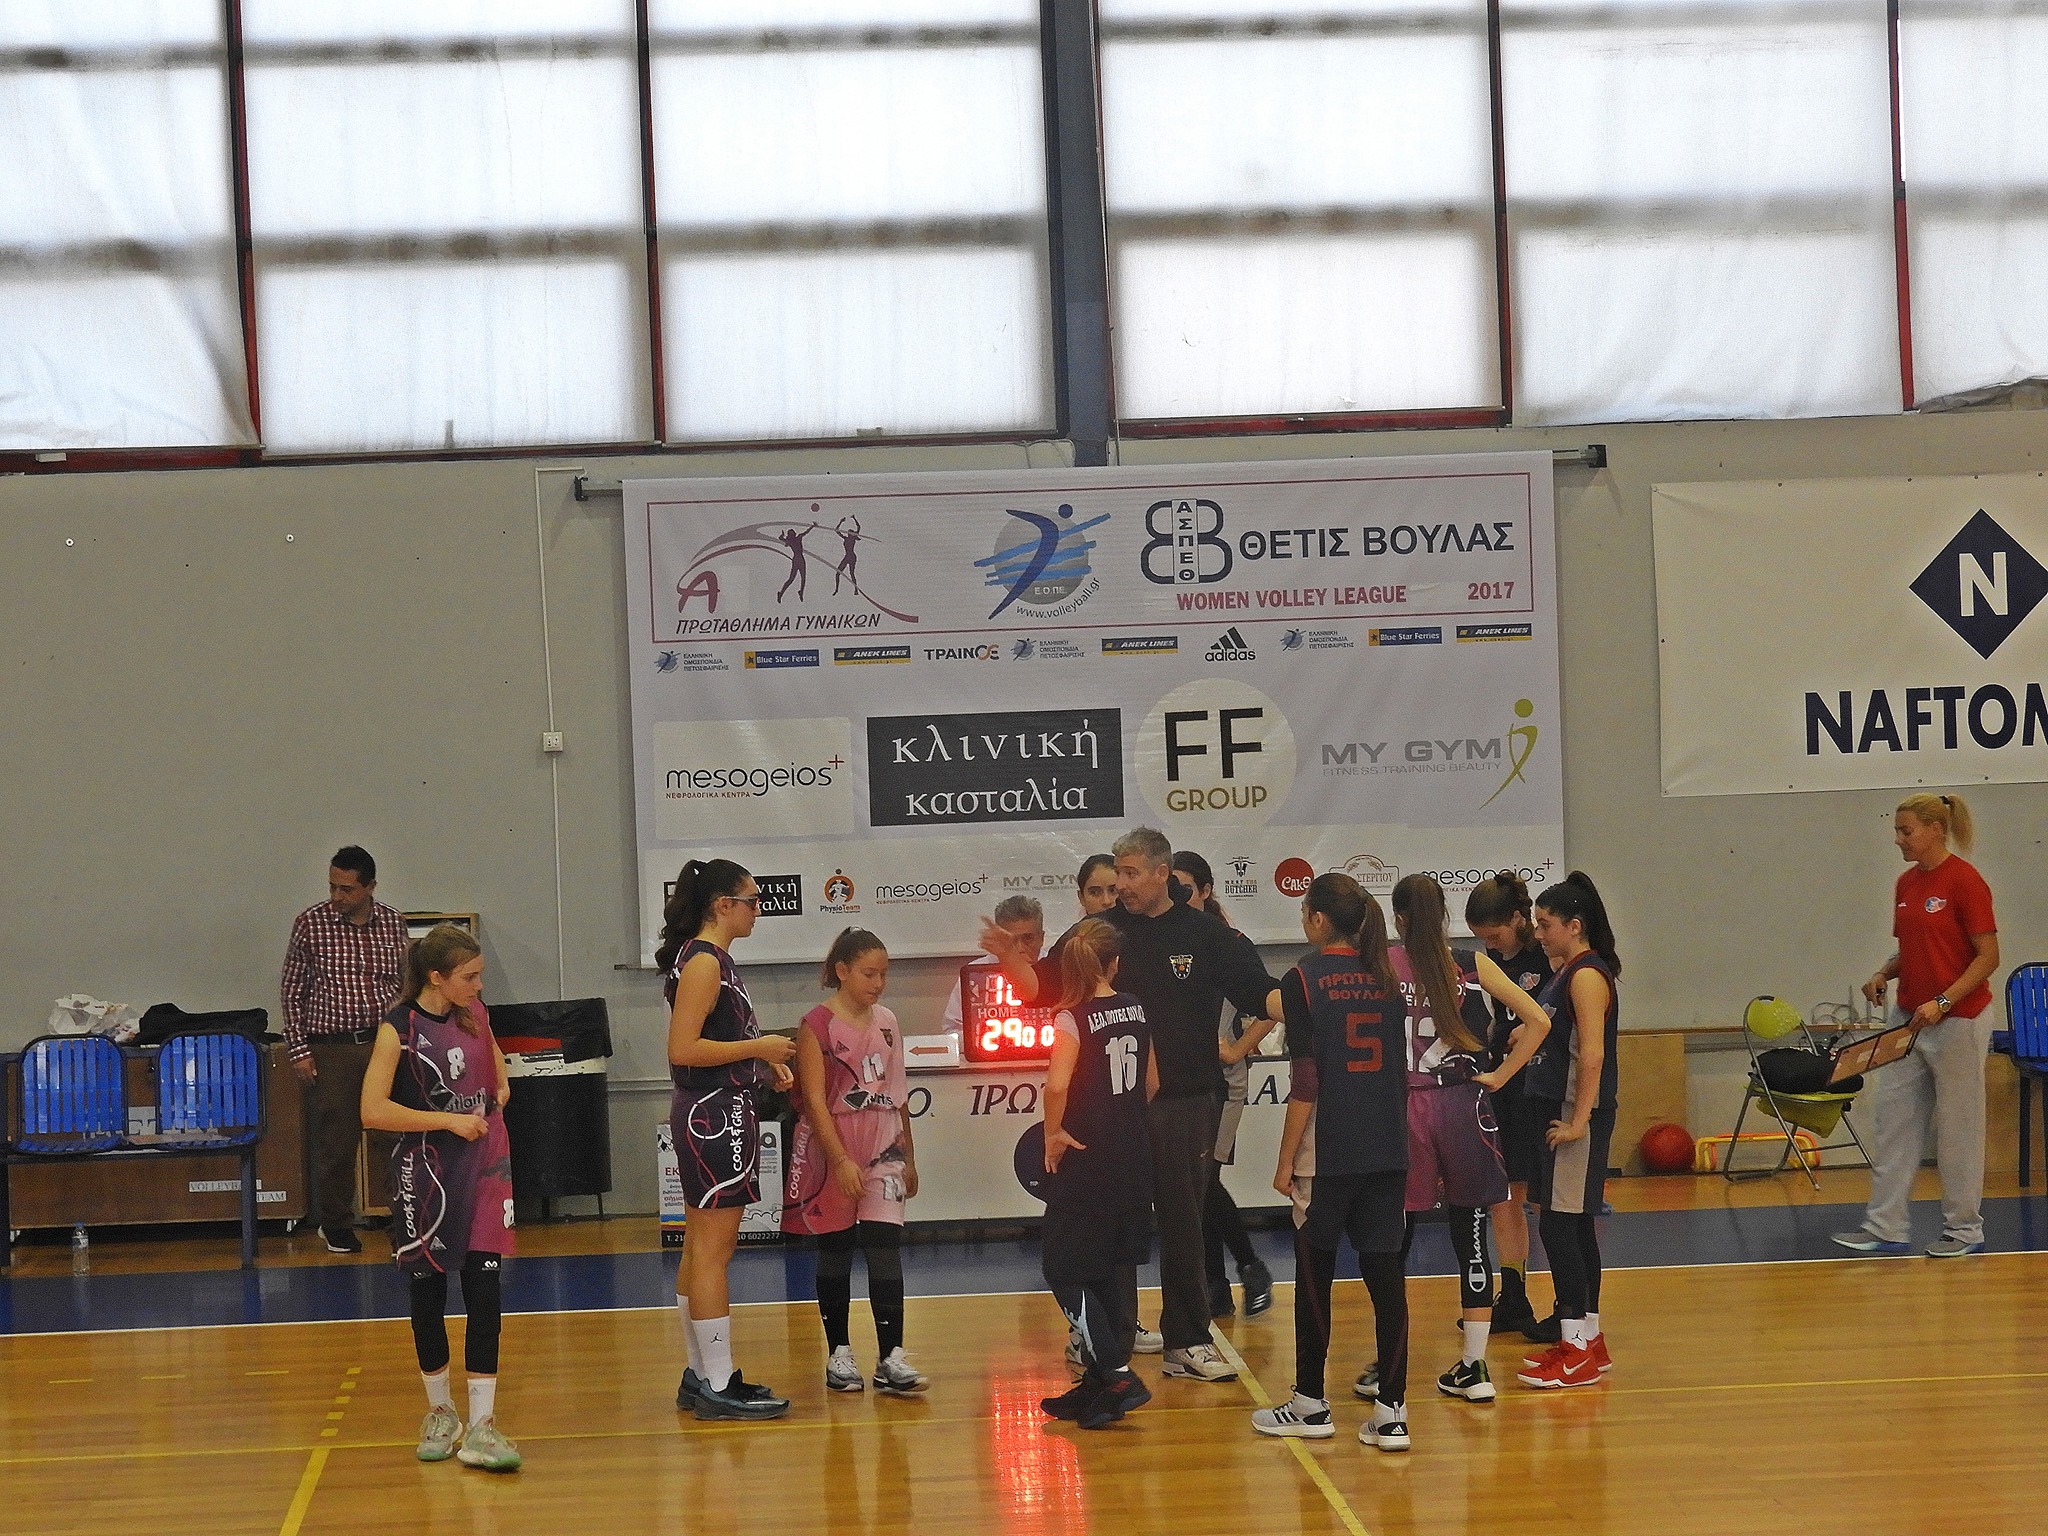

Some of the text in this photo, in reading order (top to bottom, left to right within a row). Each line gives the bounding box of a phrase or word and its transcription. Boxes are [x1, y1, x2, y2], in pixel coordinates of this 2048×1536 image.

[1238, 521, 1515, 560] ΘΕΤΙΣ ΒΟΥΛΑΣ
[1016, 577, 1101, 619] www.volleyball.gr
[1176, 585, 1407, 611] WOMEN VOLLEY LEAGUE
[1467, 581, 1515, 600] 2017
[1958, 552, 2009, 617] N
[675, 613, 881, 635] ΠΡΩΤΑΘΛΗΜΑ ΓΥΝΑΙΚΩΝ
[1380, 631, 1440, 641] Blue Star Ferries
[775, 655, 789, 663] Star
[1204, 649, 1256, 662] adidas
[891, 718, 1099, 769] κλινική
[1164, 706, 1265, 783] FF
[1321, 738, 1501, 765] MY GYM
[666, 761, 832, 797] mesogeios
[1323, 761, 1502, 776] FITNESS TRAINING BEAUTY
[905, 777, 1088, 818] κασταλία
[1165, 785, 1268, 813] GROUP
[757, 879, 798, 897] νική
[875, 879, 982, 902] mesogeios
[1003, 875, 1033, 888] MY
[978, 1006, 1019, 1019] HOME
[1345, 1012, 1383, 1073] 5
[447, 1046, 466, 1081] 8
[1104, 1034, 1138, 1096] 16
[729, 1137, 743, 1172] COOK
[402, 1203, 417, 1238] COOK
[1468, 1207, 1486, 1293] Champ
